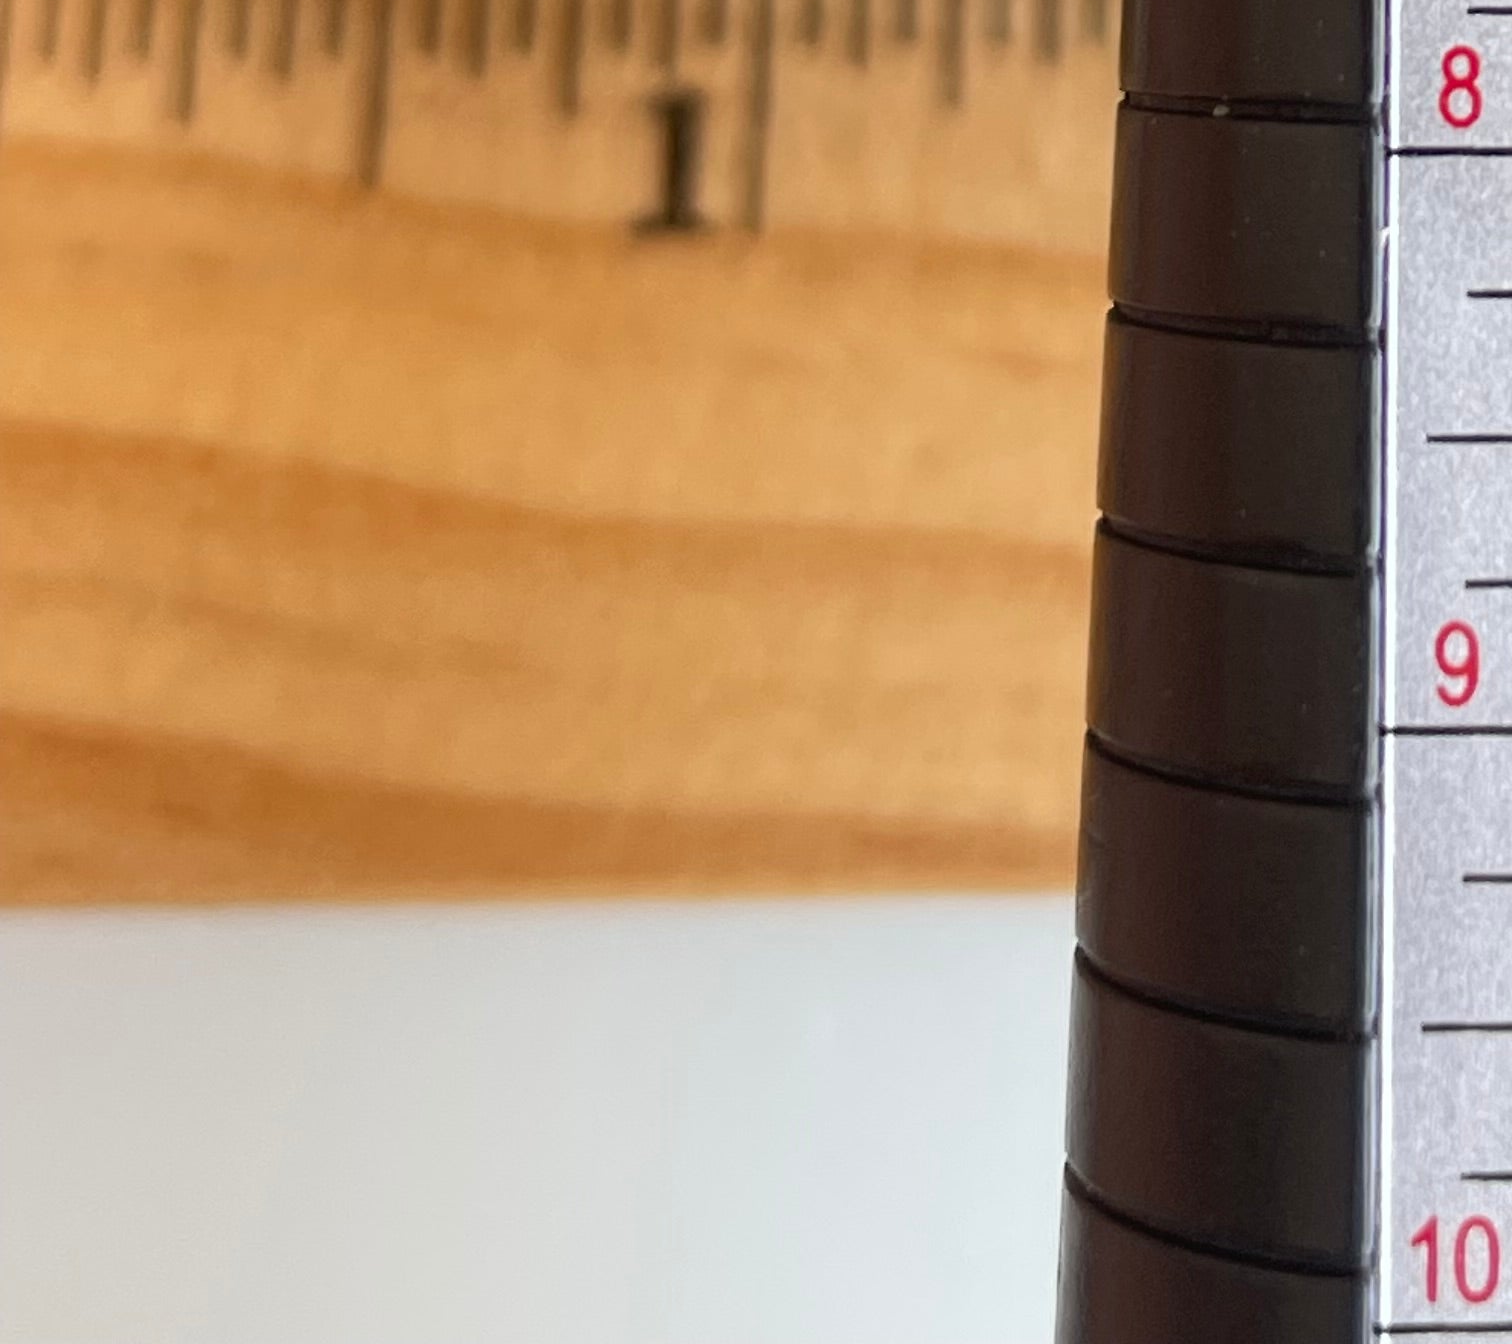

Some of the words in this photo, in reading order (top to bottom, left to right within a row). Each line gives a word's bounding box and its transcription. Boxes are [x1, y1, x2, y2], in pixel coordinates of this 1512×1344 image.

[1439, 45, 1483, 129] 8
[630, 86, 714, 238] 1
[1435, 620, 1480, 707] 9
[1412, 1216, 1500, 1303] 10
